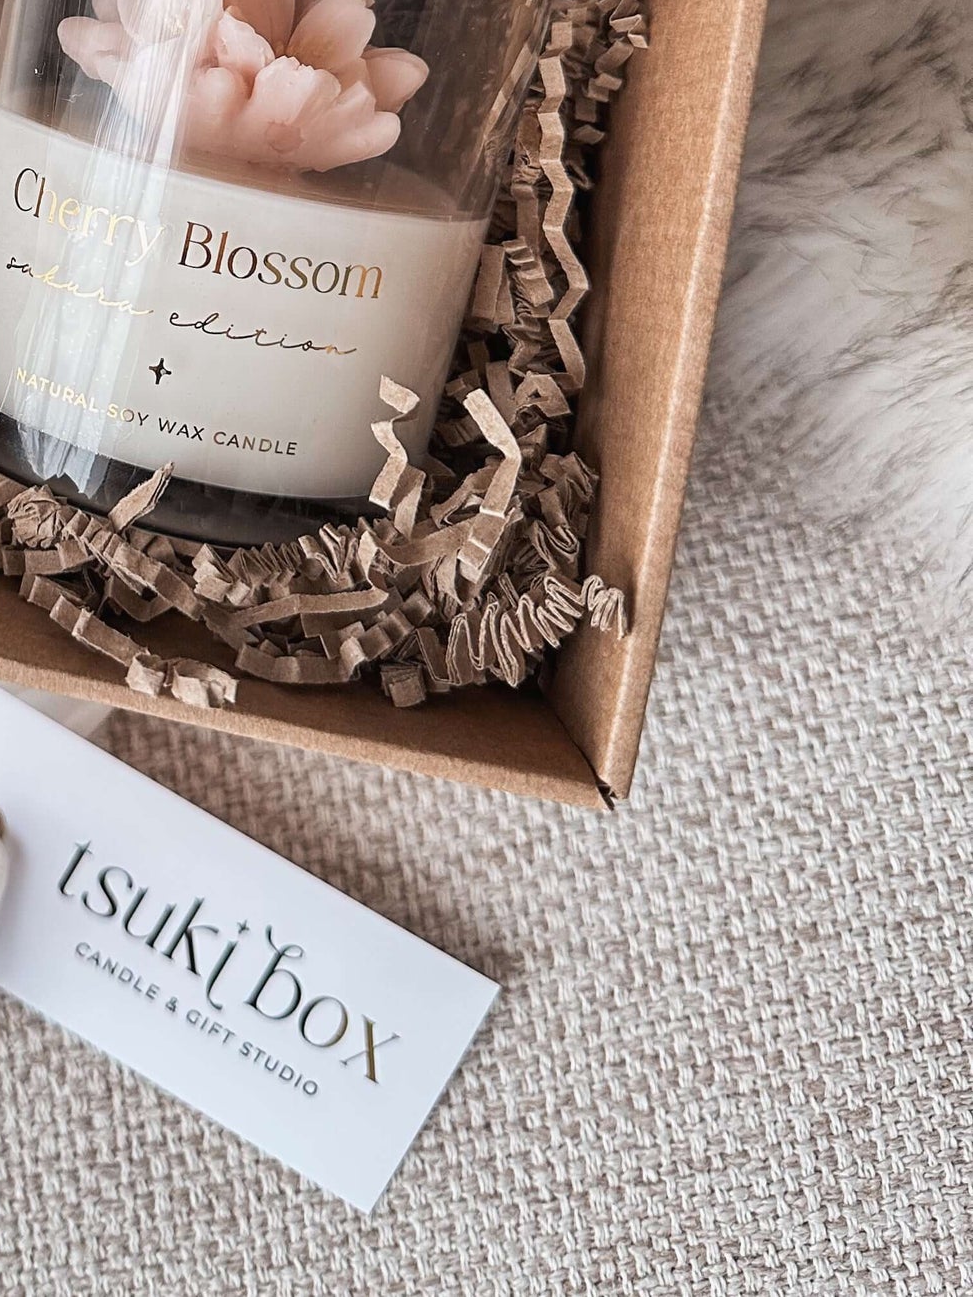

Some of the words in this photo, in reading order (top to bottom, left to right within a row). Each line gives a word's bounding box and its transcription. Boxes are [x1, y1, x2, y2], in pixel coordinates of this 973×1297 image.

[14, 167, 167, 266] Cherry
[177, 220, 384, 299] Blossom
[6, 256, 154, 316] sakura
[169, 310, 357, 356] edition
[15, 367, 99, 414] NATURAL
[106, 402, 150, 427] SOY
[157, 416, 205, 442] WAX
[213, 430, 298, 456] CANDLE
[74, 941, 161, 1000] CANDLE
[164, 995, 179, 1013] &
[186, 1008, 236, 1046] GIFT
[238, 1040, 320, 1097] STUDIO
